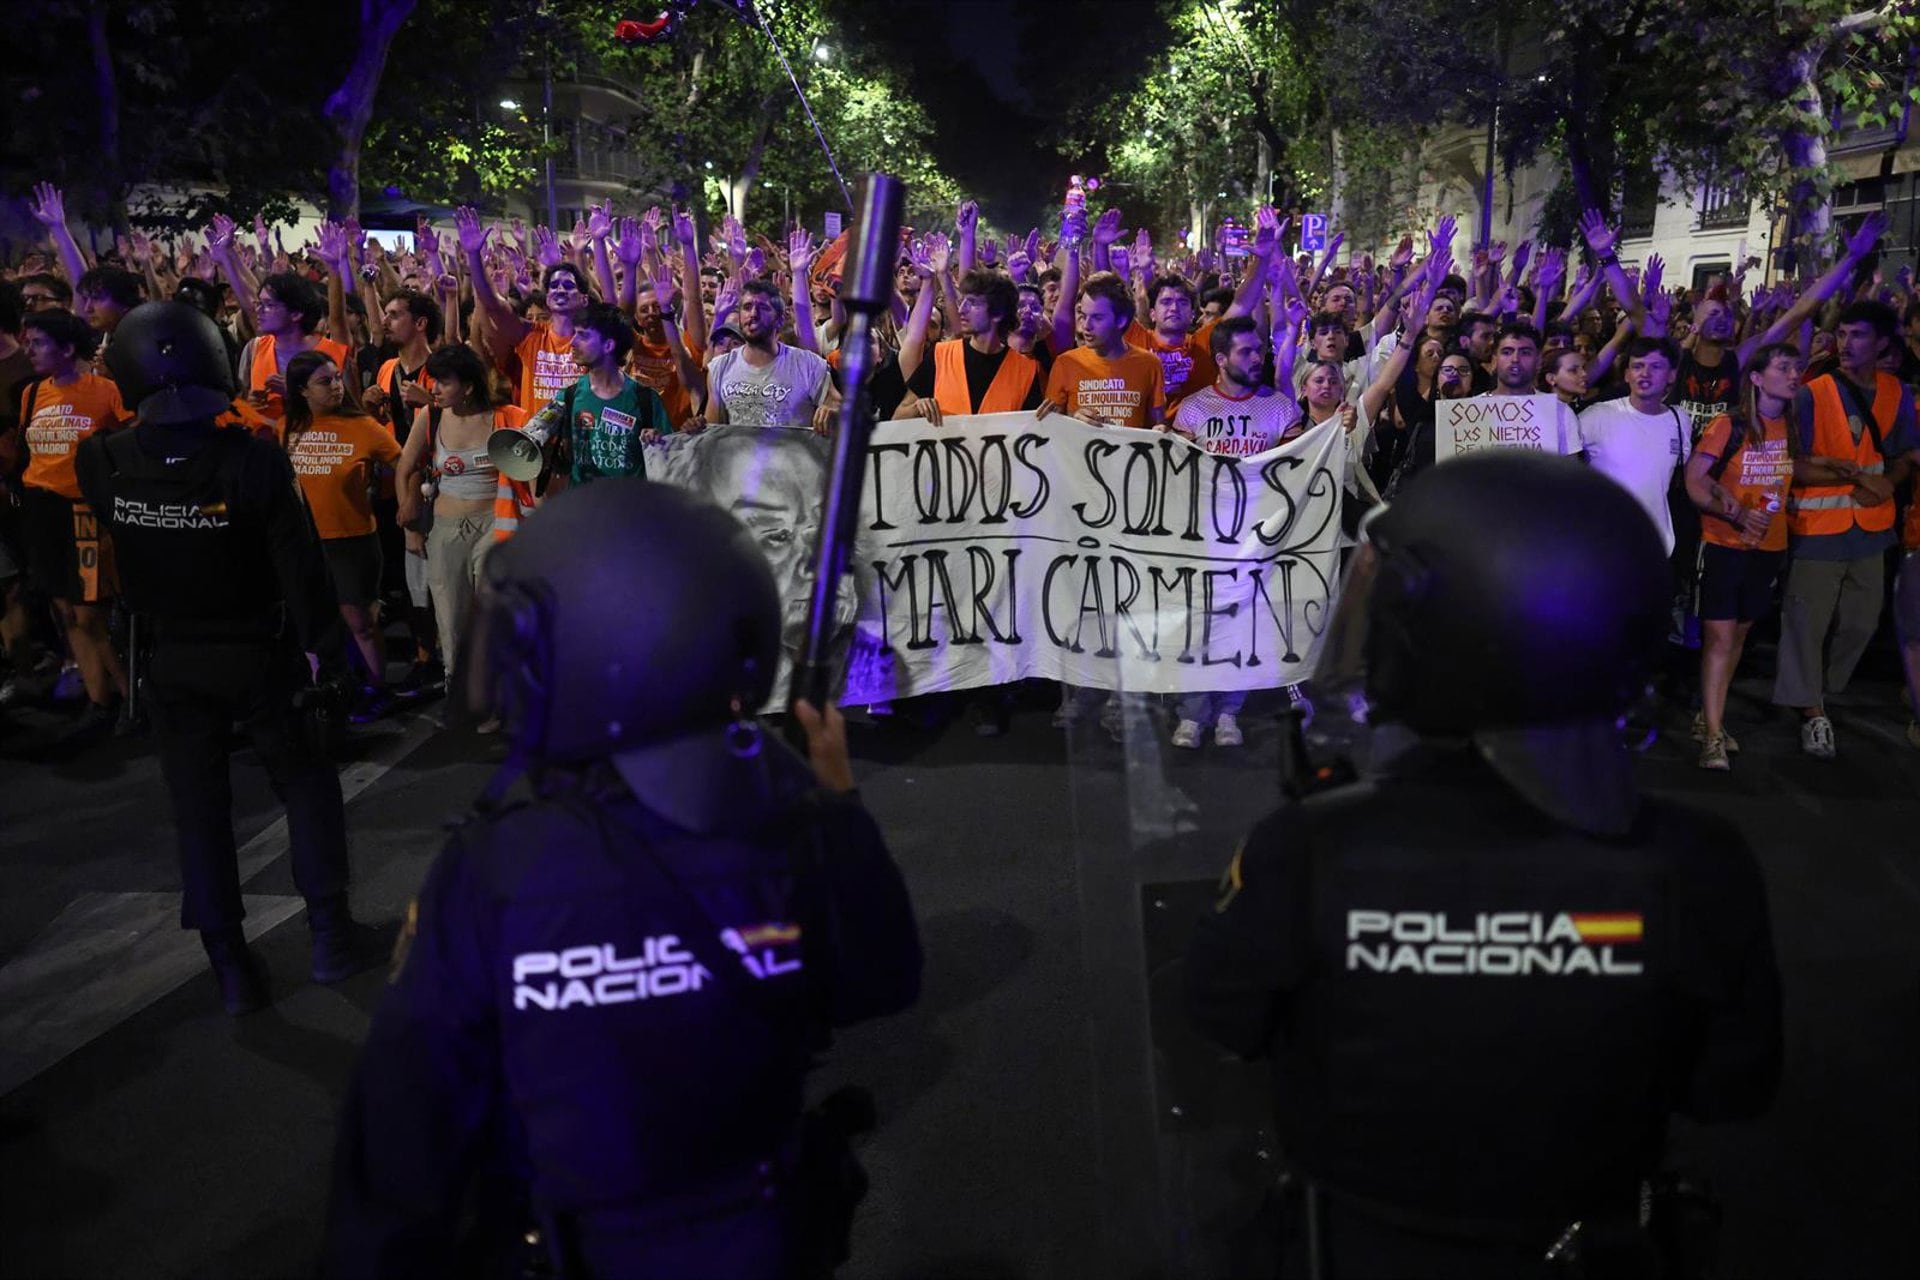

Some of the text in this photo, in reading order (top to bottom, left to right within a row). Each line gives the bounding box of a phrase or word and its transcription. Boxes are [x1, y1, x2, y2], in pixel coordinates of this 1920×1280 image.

[1306, 216, 1322, 237] P
[1079, 379, 1125, 391] SINDICATO
[1079, 391, 1139, 404] DE INQUILINAS
[1449, 399, 1534, 427] SOMOS
[1207, 415, 1252, 438] MST
[1454, 426, 1541, 443] LXS NIETXS
[868, 433, 1304, 546] TODOS SOMOS
[114, 497, 201, 517] POLICIA
[113, 510, 229, 529] NACIONAL
[872, 546, 1301, 669] MARI CARMEN
[1347, 910, 1583, 943] POLICIA
[513, 927, 748, 983] POLIC
[1346, 944, 1643, 975] NACIONAL
